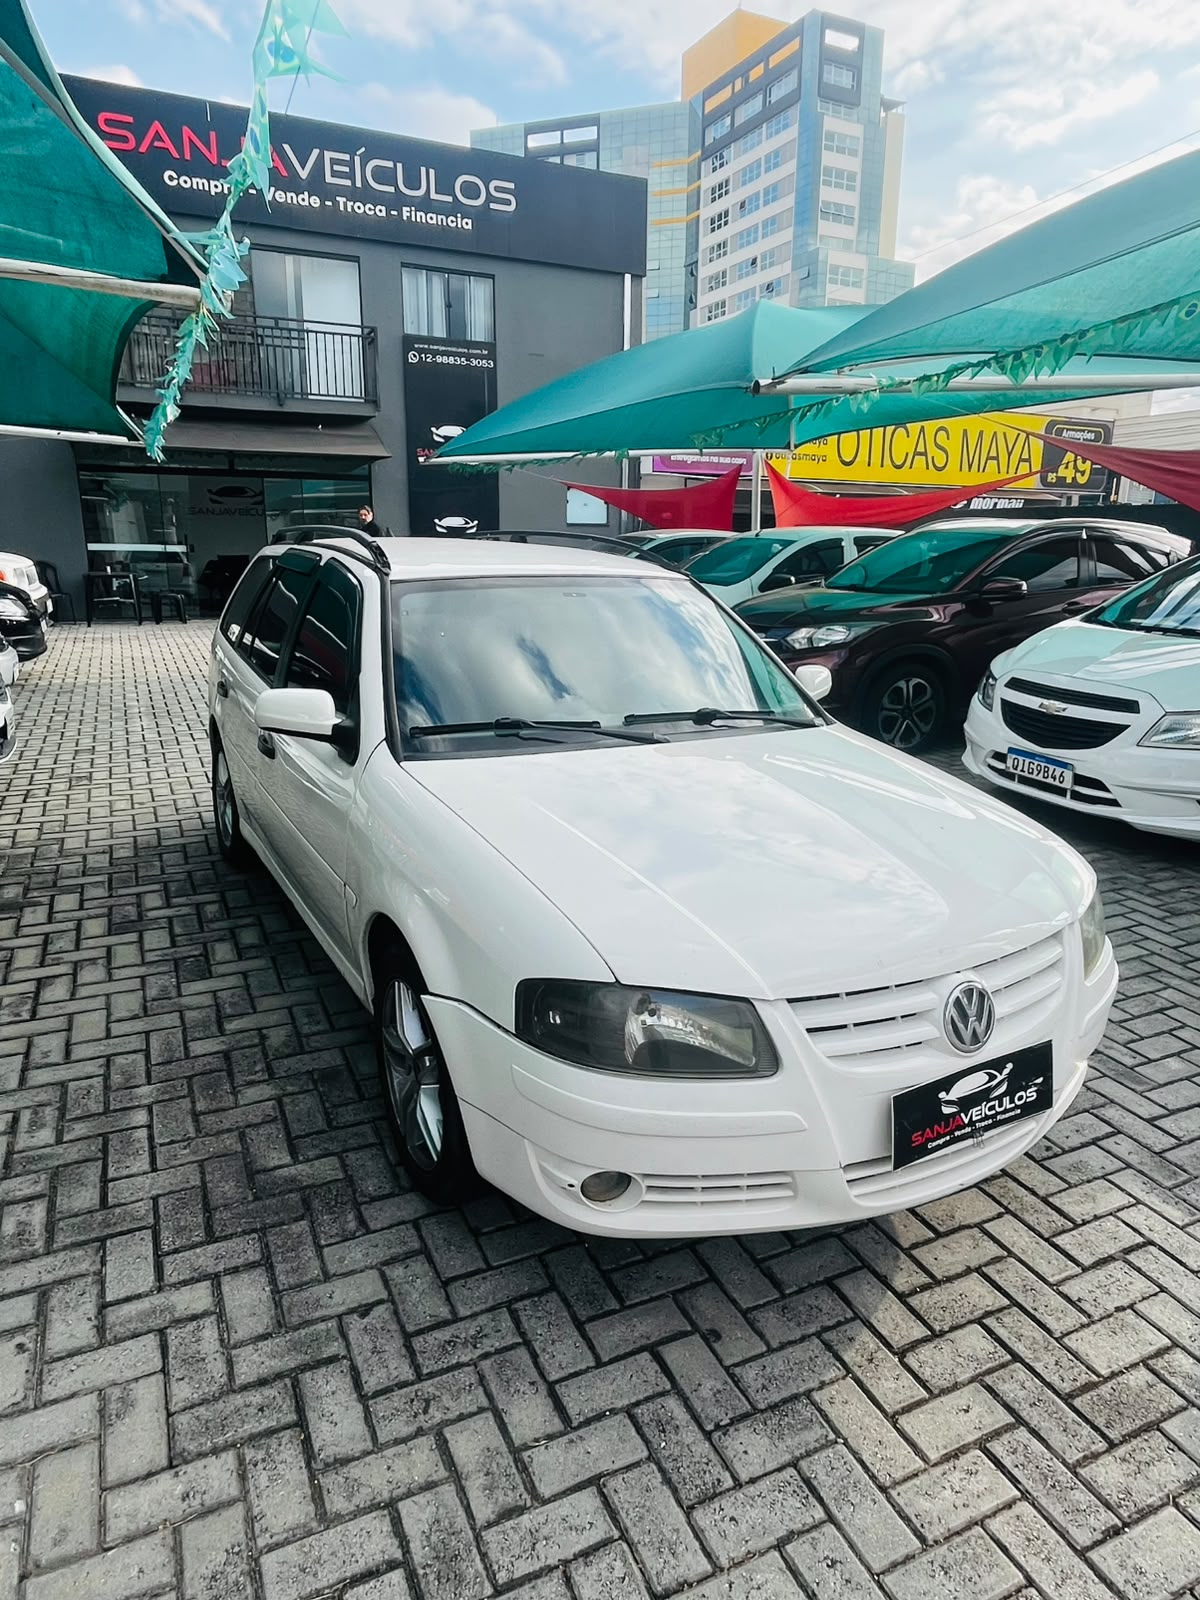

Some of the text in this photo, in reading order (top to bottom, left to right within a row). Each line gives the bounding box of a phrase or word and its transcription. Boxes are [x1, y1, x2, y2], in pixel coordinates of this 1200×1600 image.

[97, 111, 517, 213] SANVEÍCULOS
[163, 169, 243, 197] Compr
[336, 196, 387, 218] Troca
[402, 206, 473, 231] Financia
[420, 353, 494, 368] 12-98835-3053
[959, 428, 1032, 475] MAYA
[1058, 451, 1092, 485] 49
[1012, 757, 1065, 784] QIG9B46
